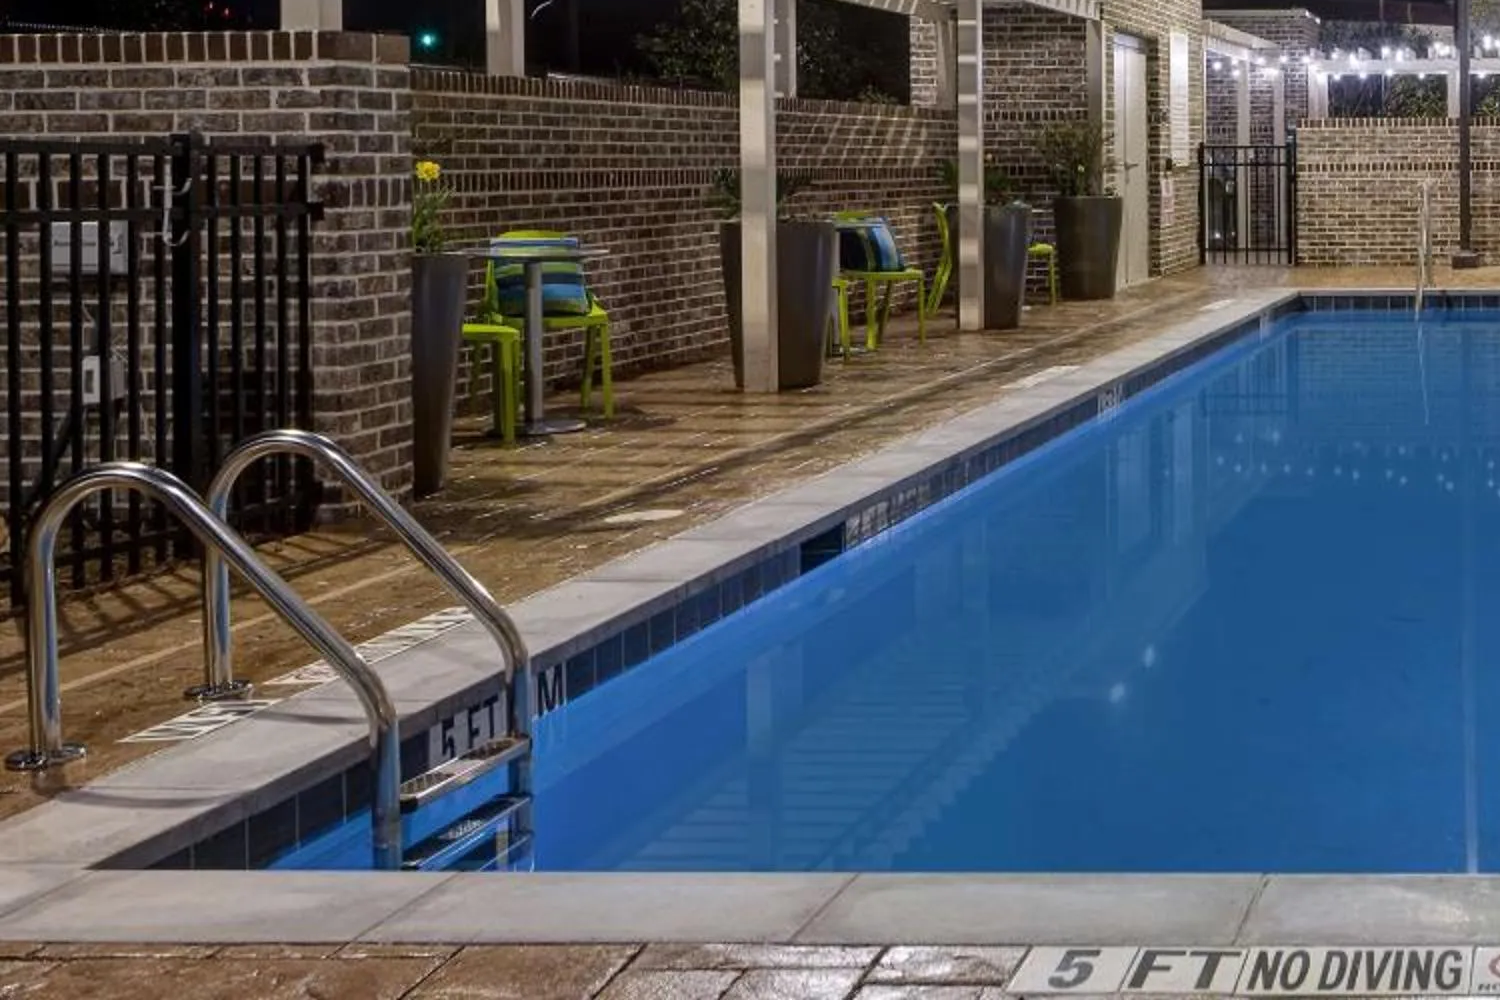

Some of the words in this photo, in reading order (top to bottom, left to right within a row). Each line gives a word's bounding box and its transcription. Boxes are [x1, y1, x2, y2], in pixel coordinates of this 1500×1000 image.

[1048, 950, 1102, 989] 5
[1128, 950, 1242, 989] FT
[1247, 950, 1311, 991] NO
[1317, 950, 1463, 991] DIVING
